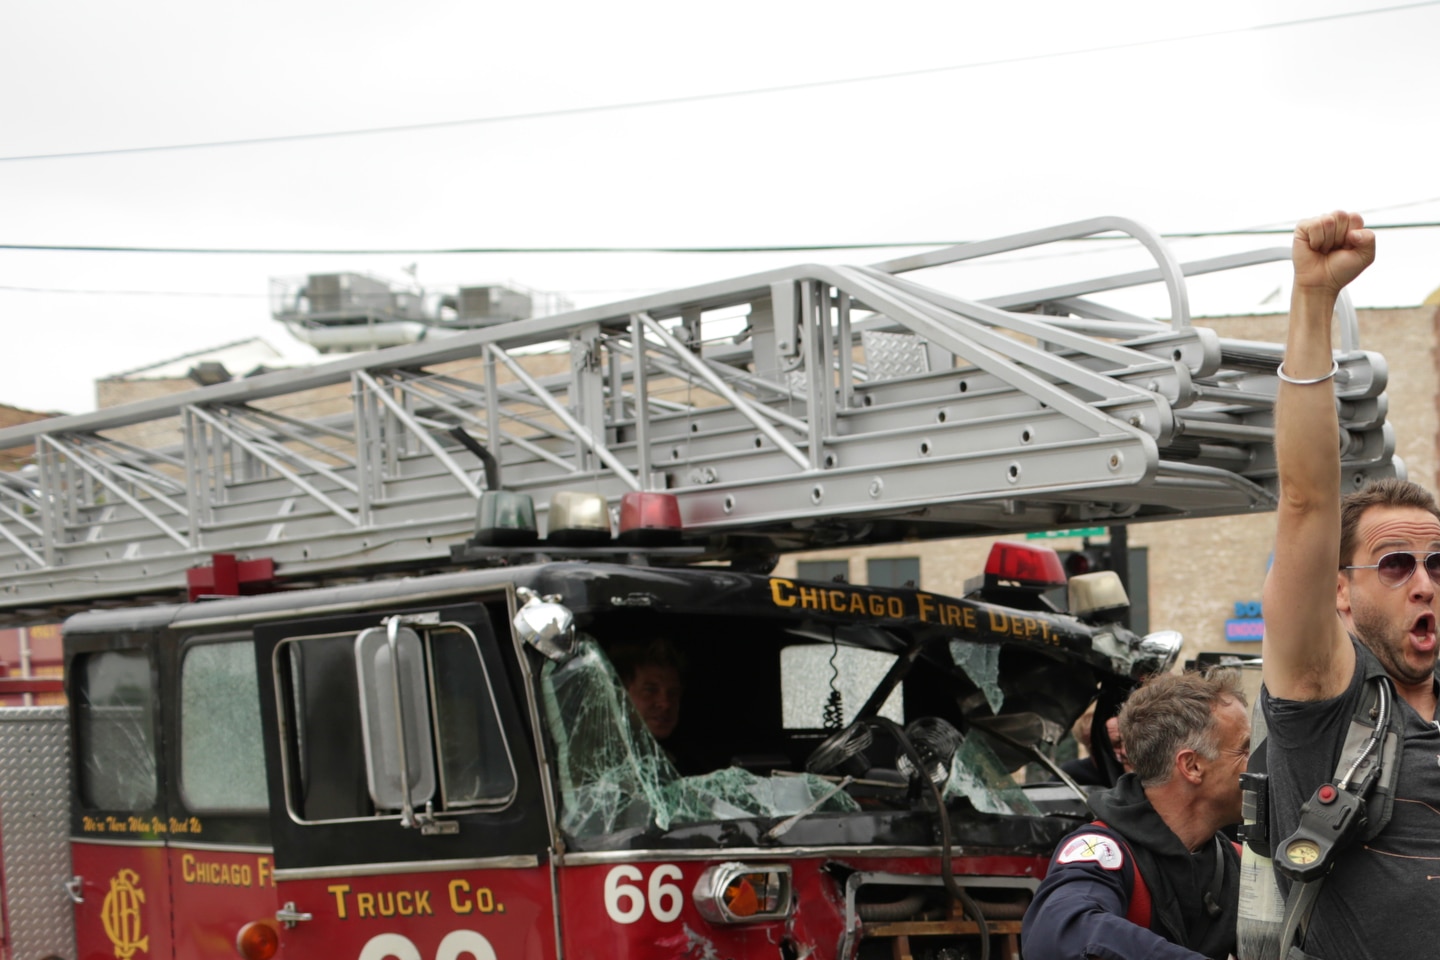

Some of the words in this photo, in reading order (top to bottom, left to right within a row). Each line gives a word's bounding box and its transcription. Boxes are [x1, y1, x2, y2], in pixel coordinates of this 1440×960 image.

[769, 578, 905, 618] CHICAGO
[916, 592, 977, 629] FIRE
[989, 609, 1060, 646] DEPT.
[128, 816, 150, 832] When
[151, 816, 167, 835] You
[168, 817, 189, 833] Need
[182, 854, 252, 887] CHICAGO
[327, 884, 434, 920] TRUCK
[448, 879, 506, 915] CO.
[604, 864, 684, 924] 66
